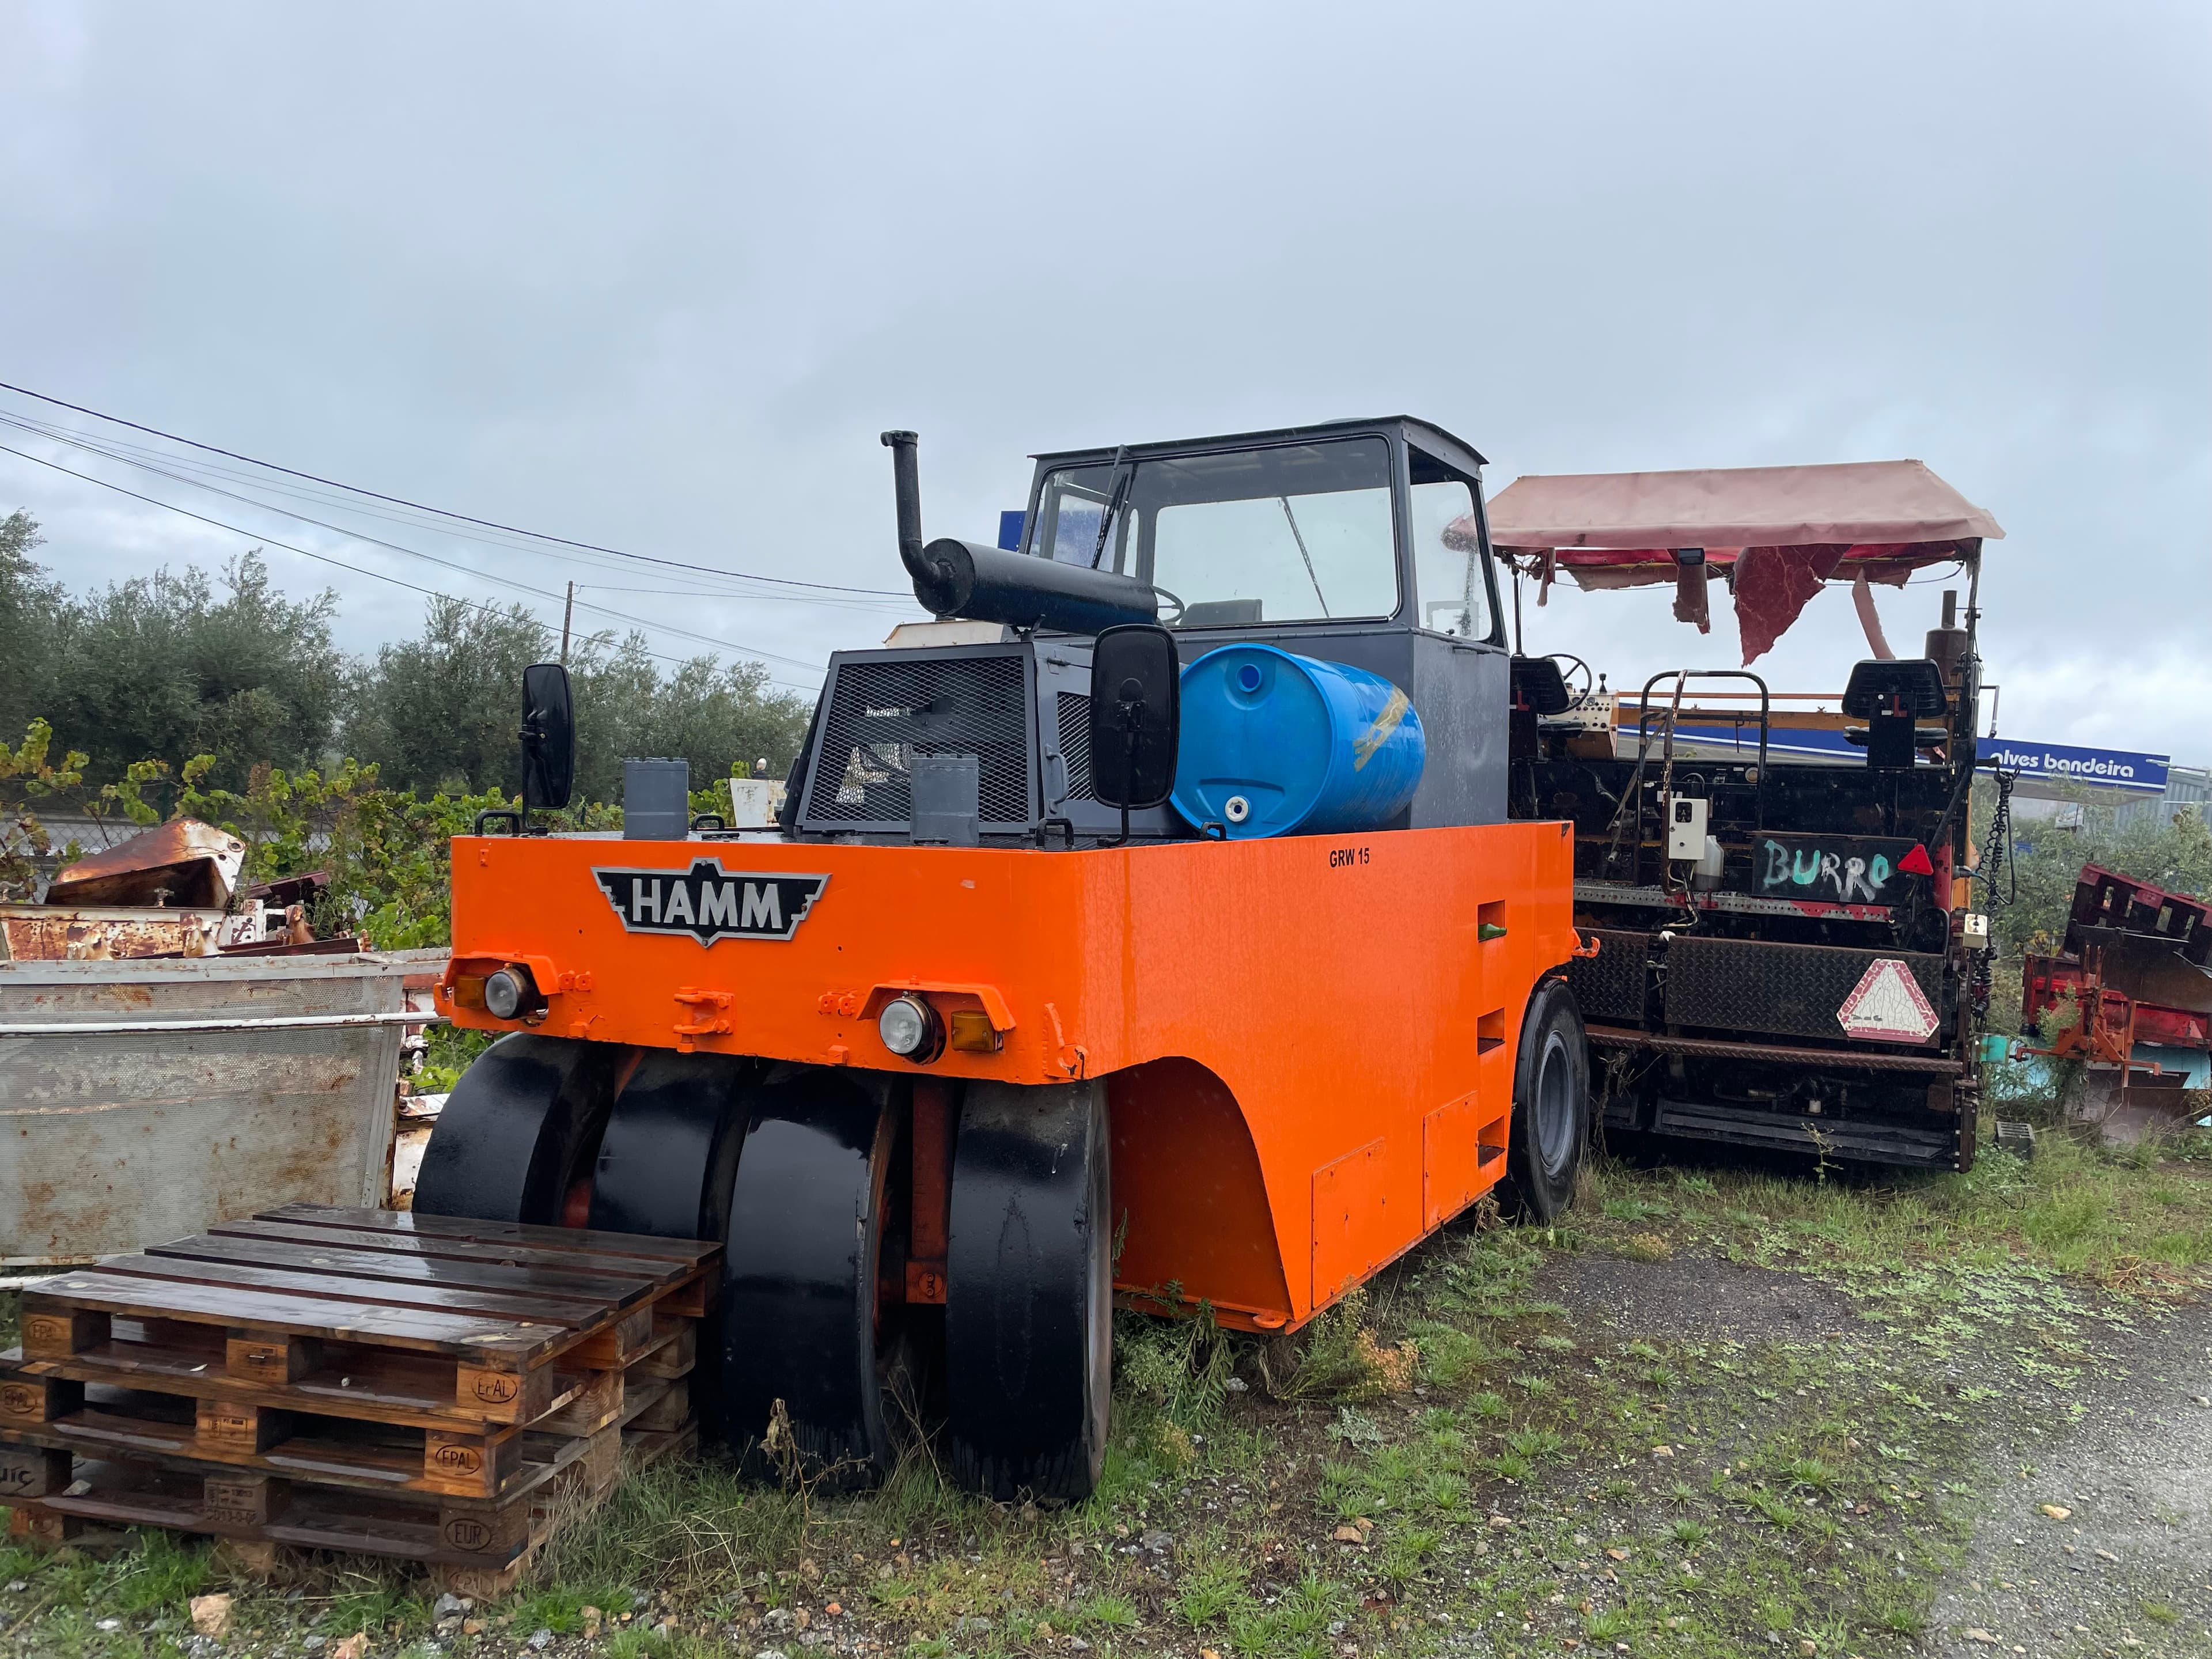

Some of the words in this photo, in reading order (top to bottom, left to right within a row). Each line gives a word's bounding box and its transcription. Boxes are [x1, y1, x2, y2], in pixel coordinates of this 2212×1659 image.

[2044, 753, 2134, 778] bandeira
[1330, 849, 1355, 868] GRW
[1358, 847, 1370, 865] 15
[1763, 839, 1889, 903] BURRO
[632, 878, 783, 929] HAMM
[442, 1450, 474, 1470] EPAL
[454, 1524, 482, 1545] EUR
